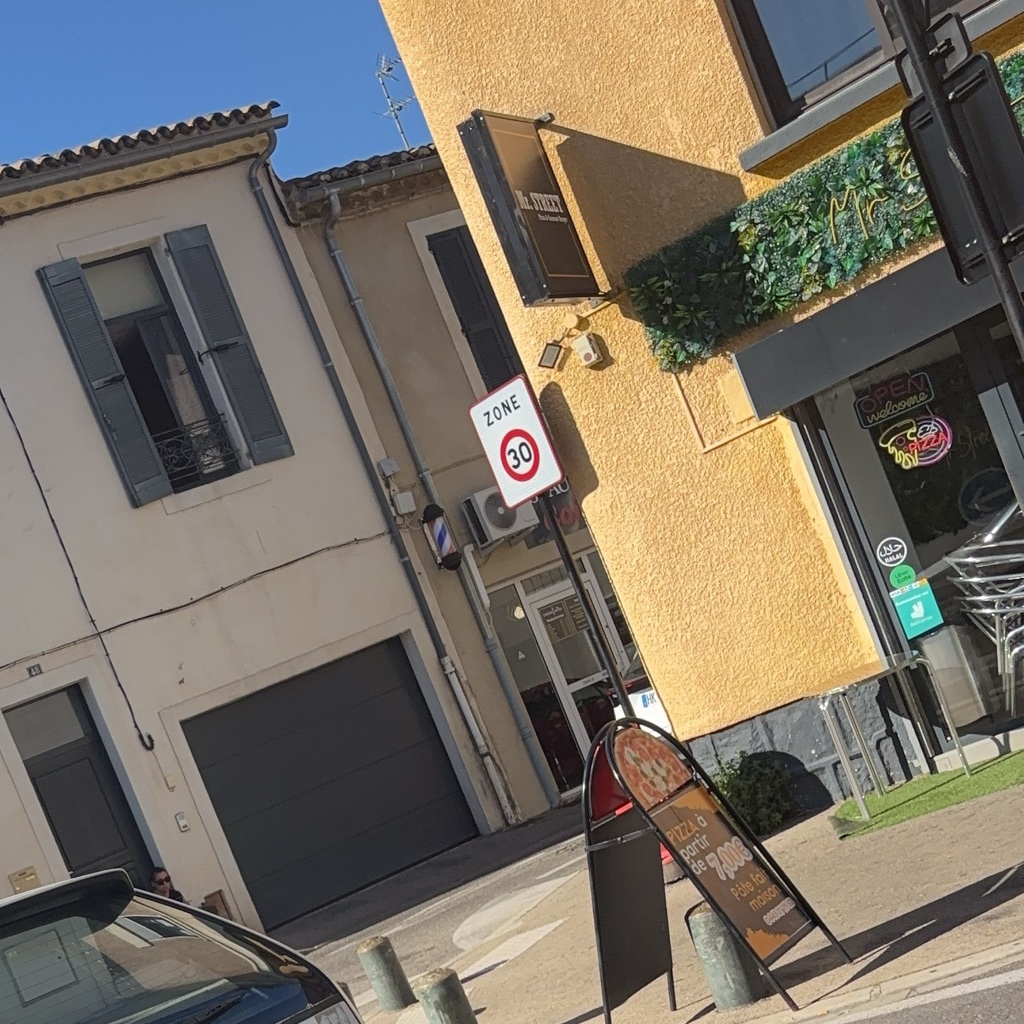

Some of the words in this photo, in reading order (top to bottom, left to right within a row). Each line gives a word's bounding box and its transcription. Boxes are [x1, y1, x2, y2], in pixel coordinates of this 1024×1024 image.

[529, 192, 564, 213] STREET
[861, 375, 925, 413] OPEN
[483, 394, 521, 427] ZONE
[866, 392, 928, 424] welcome
[507, 441, 532, 470] 30
[909, 431, 948, 455] PIZZA
[879, 543, 903, 558] حلال
[884, 553, 904, 563] HALAL
[666, 820, 700, 847] PIZZA
[680, 834, 710, 864] partir
[691, 859, 707, 875] de
[749, 884, 781, 912] maison
